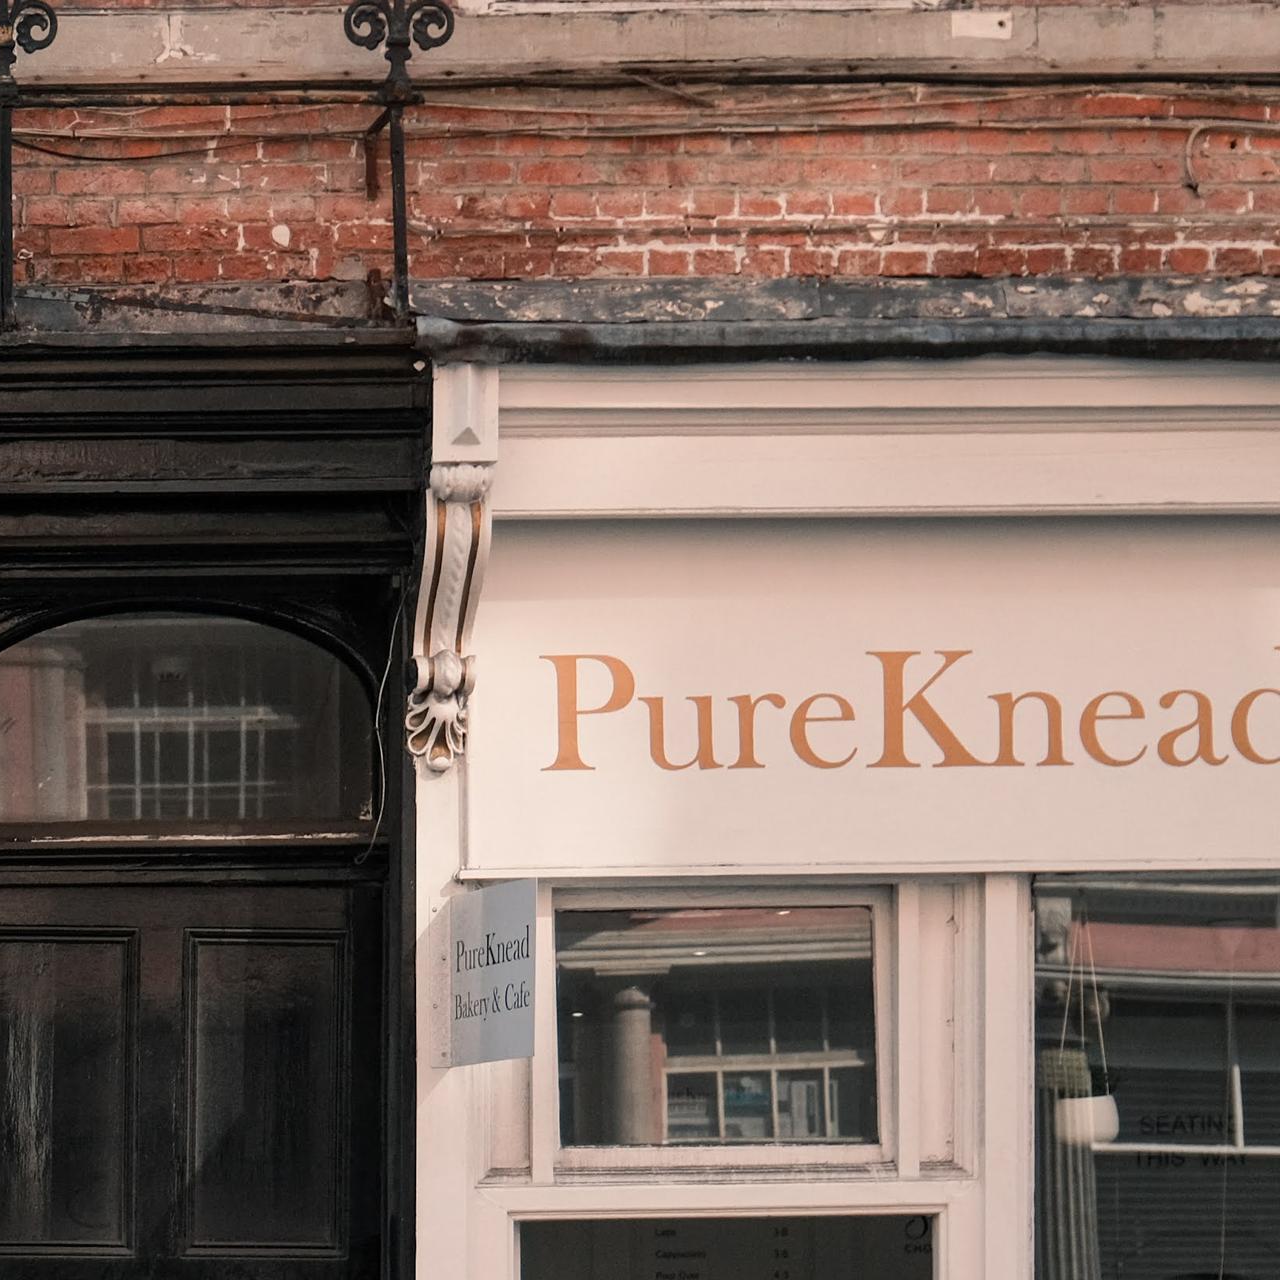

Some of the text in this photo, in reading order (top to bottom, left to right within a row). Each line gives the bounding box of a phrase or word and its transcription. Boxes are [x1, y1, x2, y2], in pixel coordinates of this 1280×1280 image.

[455, 924, 530, 974] PureKnead
[454, 980, 531, 1022] Bakery & Cafe
